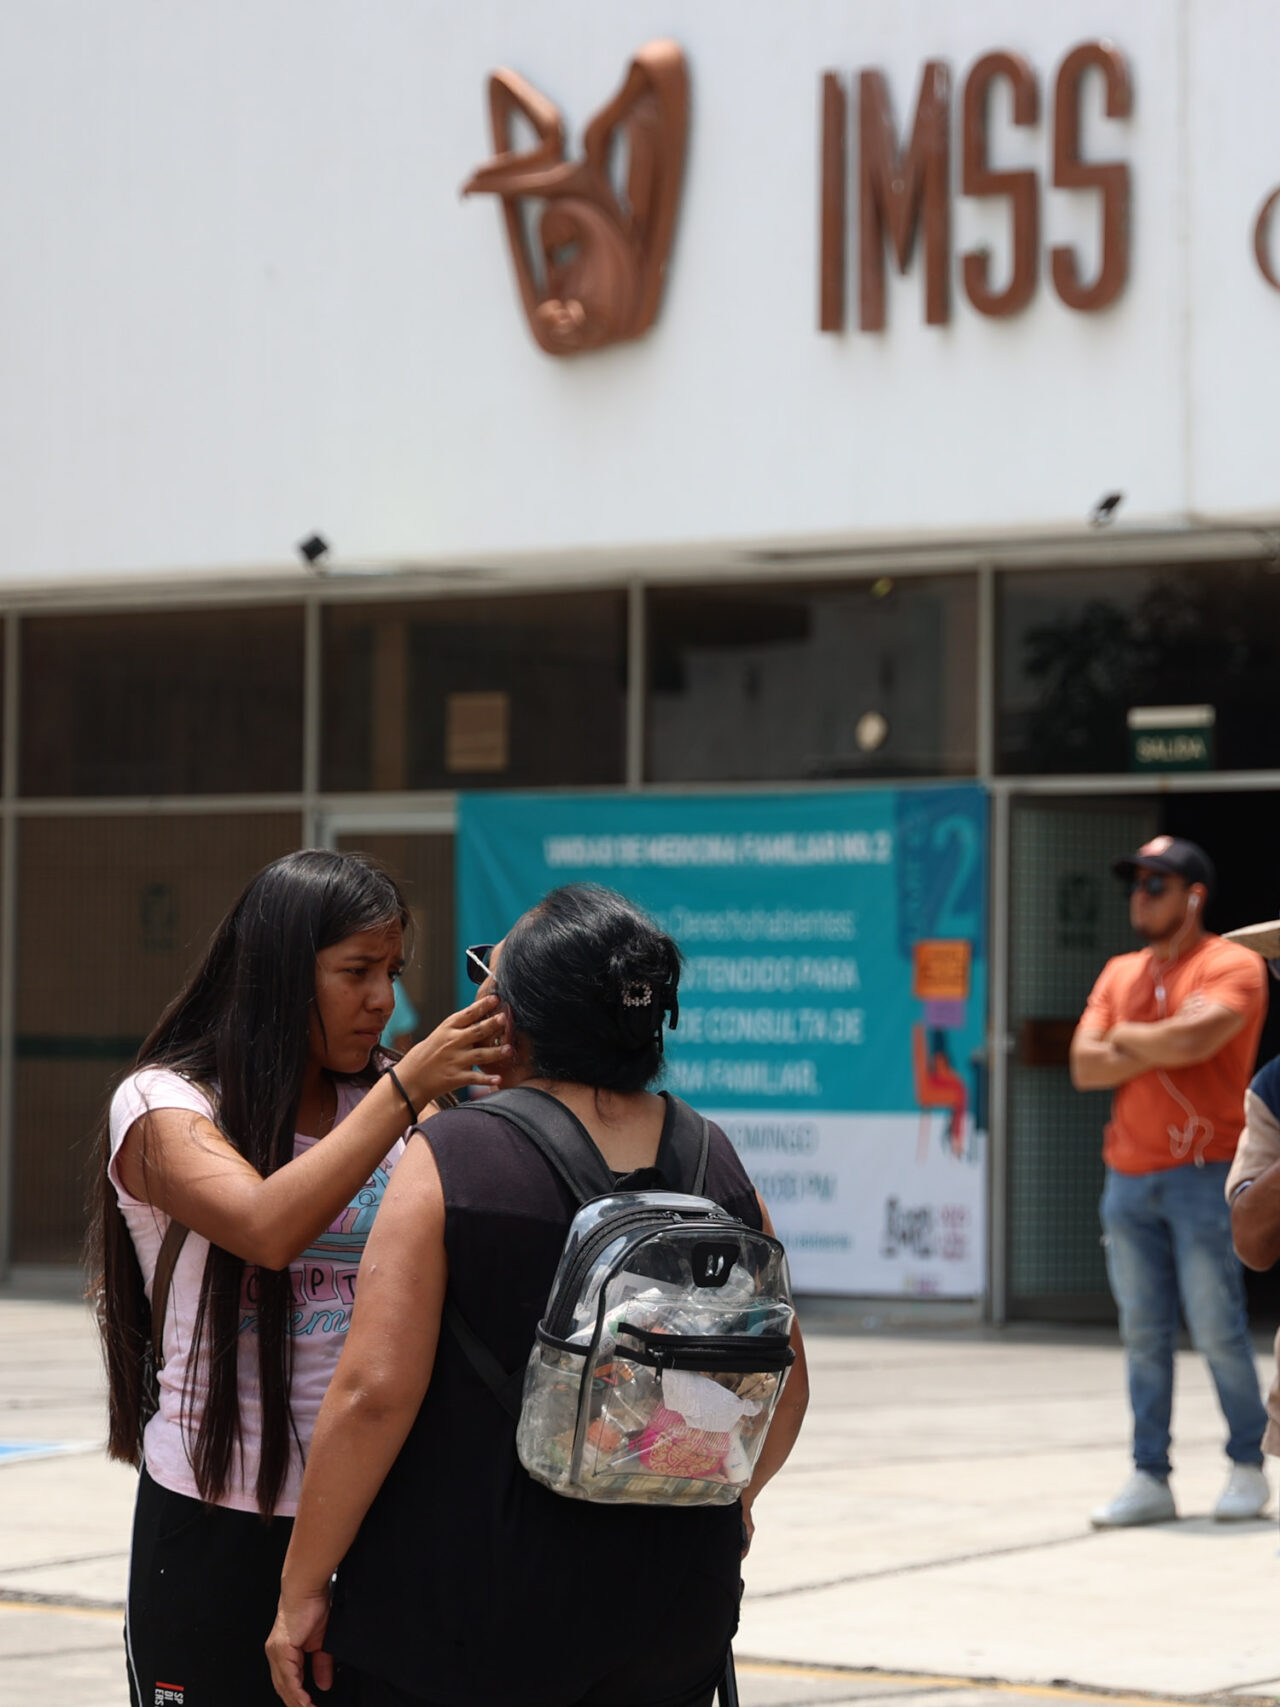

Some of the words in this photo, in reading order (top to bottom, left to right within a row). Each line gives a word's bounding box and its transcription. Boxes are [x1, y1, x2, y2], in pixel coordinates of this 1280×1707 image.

[818, 40, 1132, 333] IMSS
[1136, 735, 1207, 762] SALIDA
[545, 836, 616, 867] UNIDAD
[617, 836, 645, 867] DE
[646, 834, 740, 866] MEDICINA
[741, 832, 838, 865] FAMILIAR
[934, 814, 978, 936] 2
[798, 956, 859, 991] PARA
[706, 1008, 829, 1043] CONSULTA
[830, 1007, 863, 1043] DE
[154, 1688, 165, 1707] ERS
